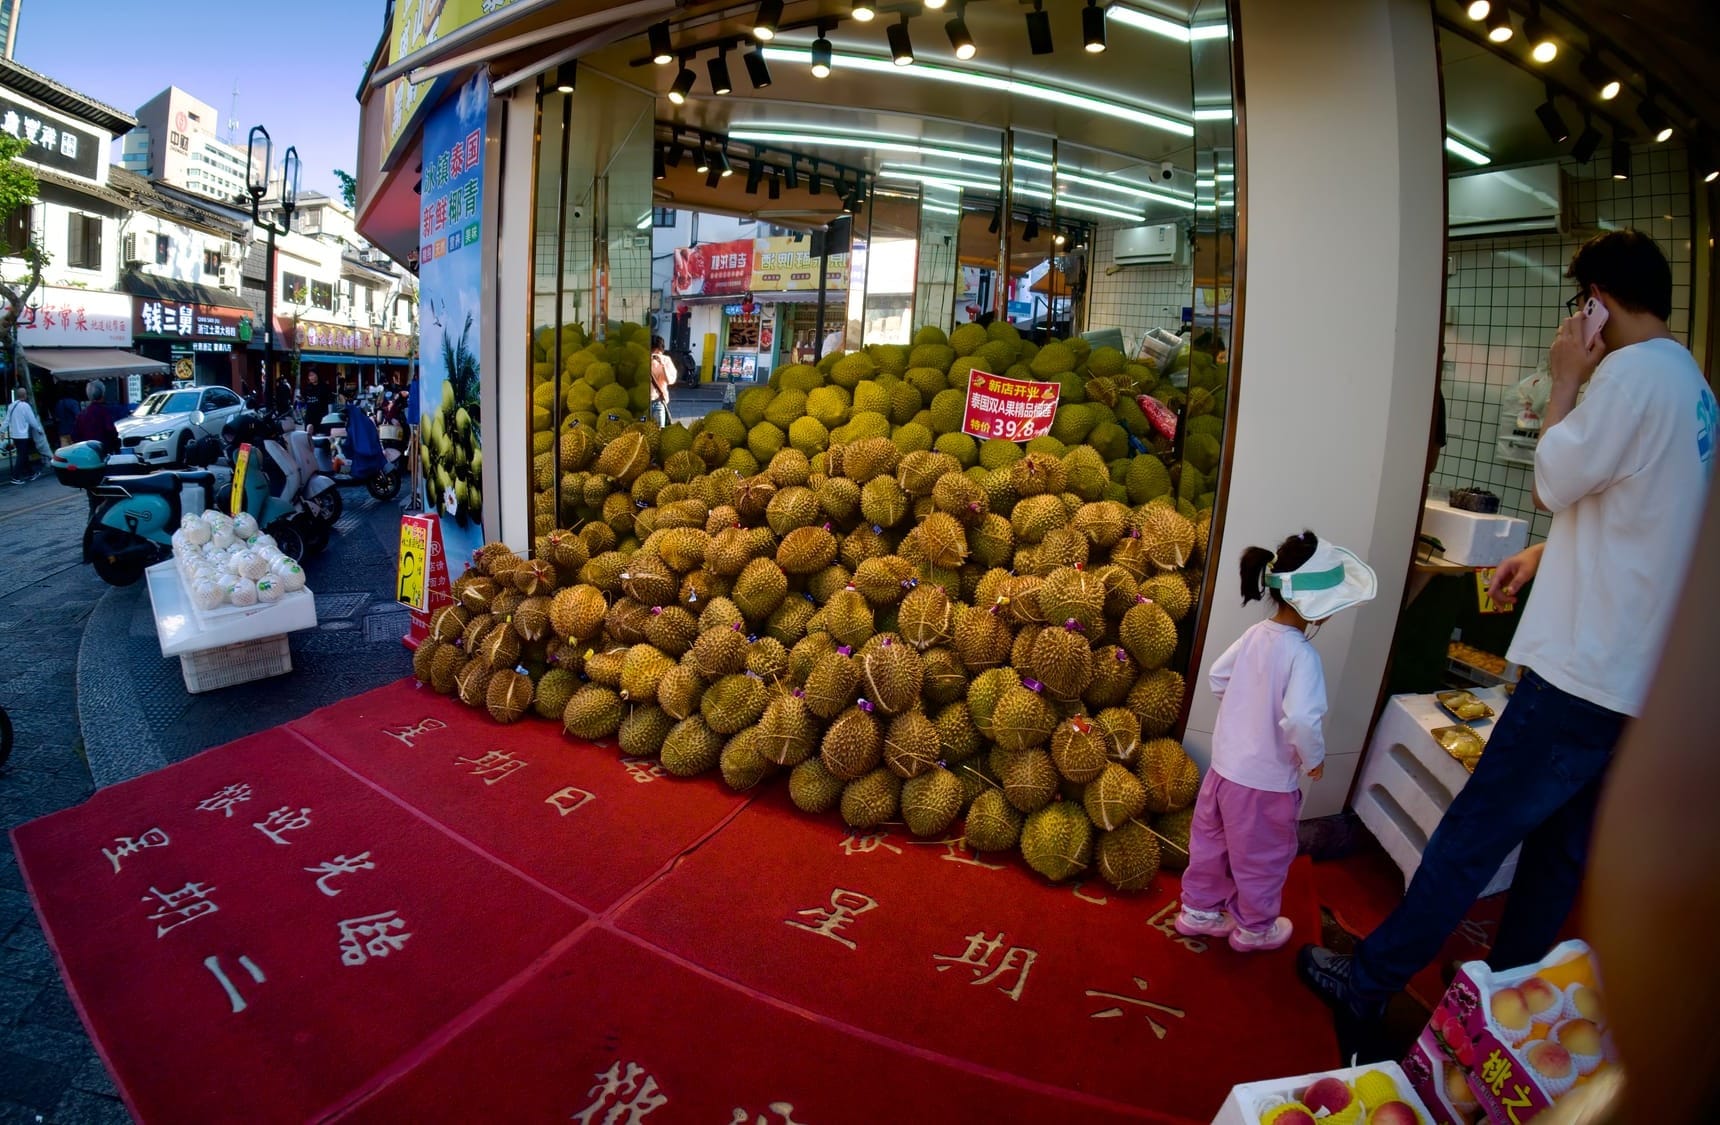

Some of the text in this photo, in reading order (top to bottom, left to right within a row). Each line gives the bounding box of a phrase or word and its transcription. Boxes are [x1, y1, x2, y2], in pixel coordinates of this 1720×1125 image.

[424, 128, 480, 193] 冰镇泰国
[423, 177, 479, 238] 新鲜椰青
[141, 302, 193, 335] 钱三舅
[988, 379, 1040, 399] 新店开业
[970, 418, 991, 433] 特价
[993, 418, 1035, 438] 39.8
[382, 717, 597, 817] 星期日
[101, 827, 267, 1014] 星期二
[784, 887, 1186, 1040] 星期六
